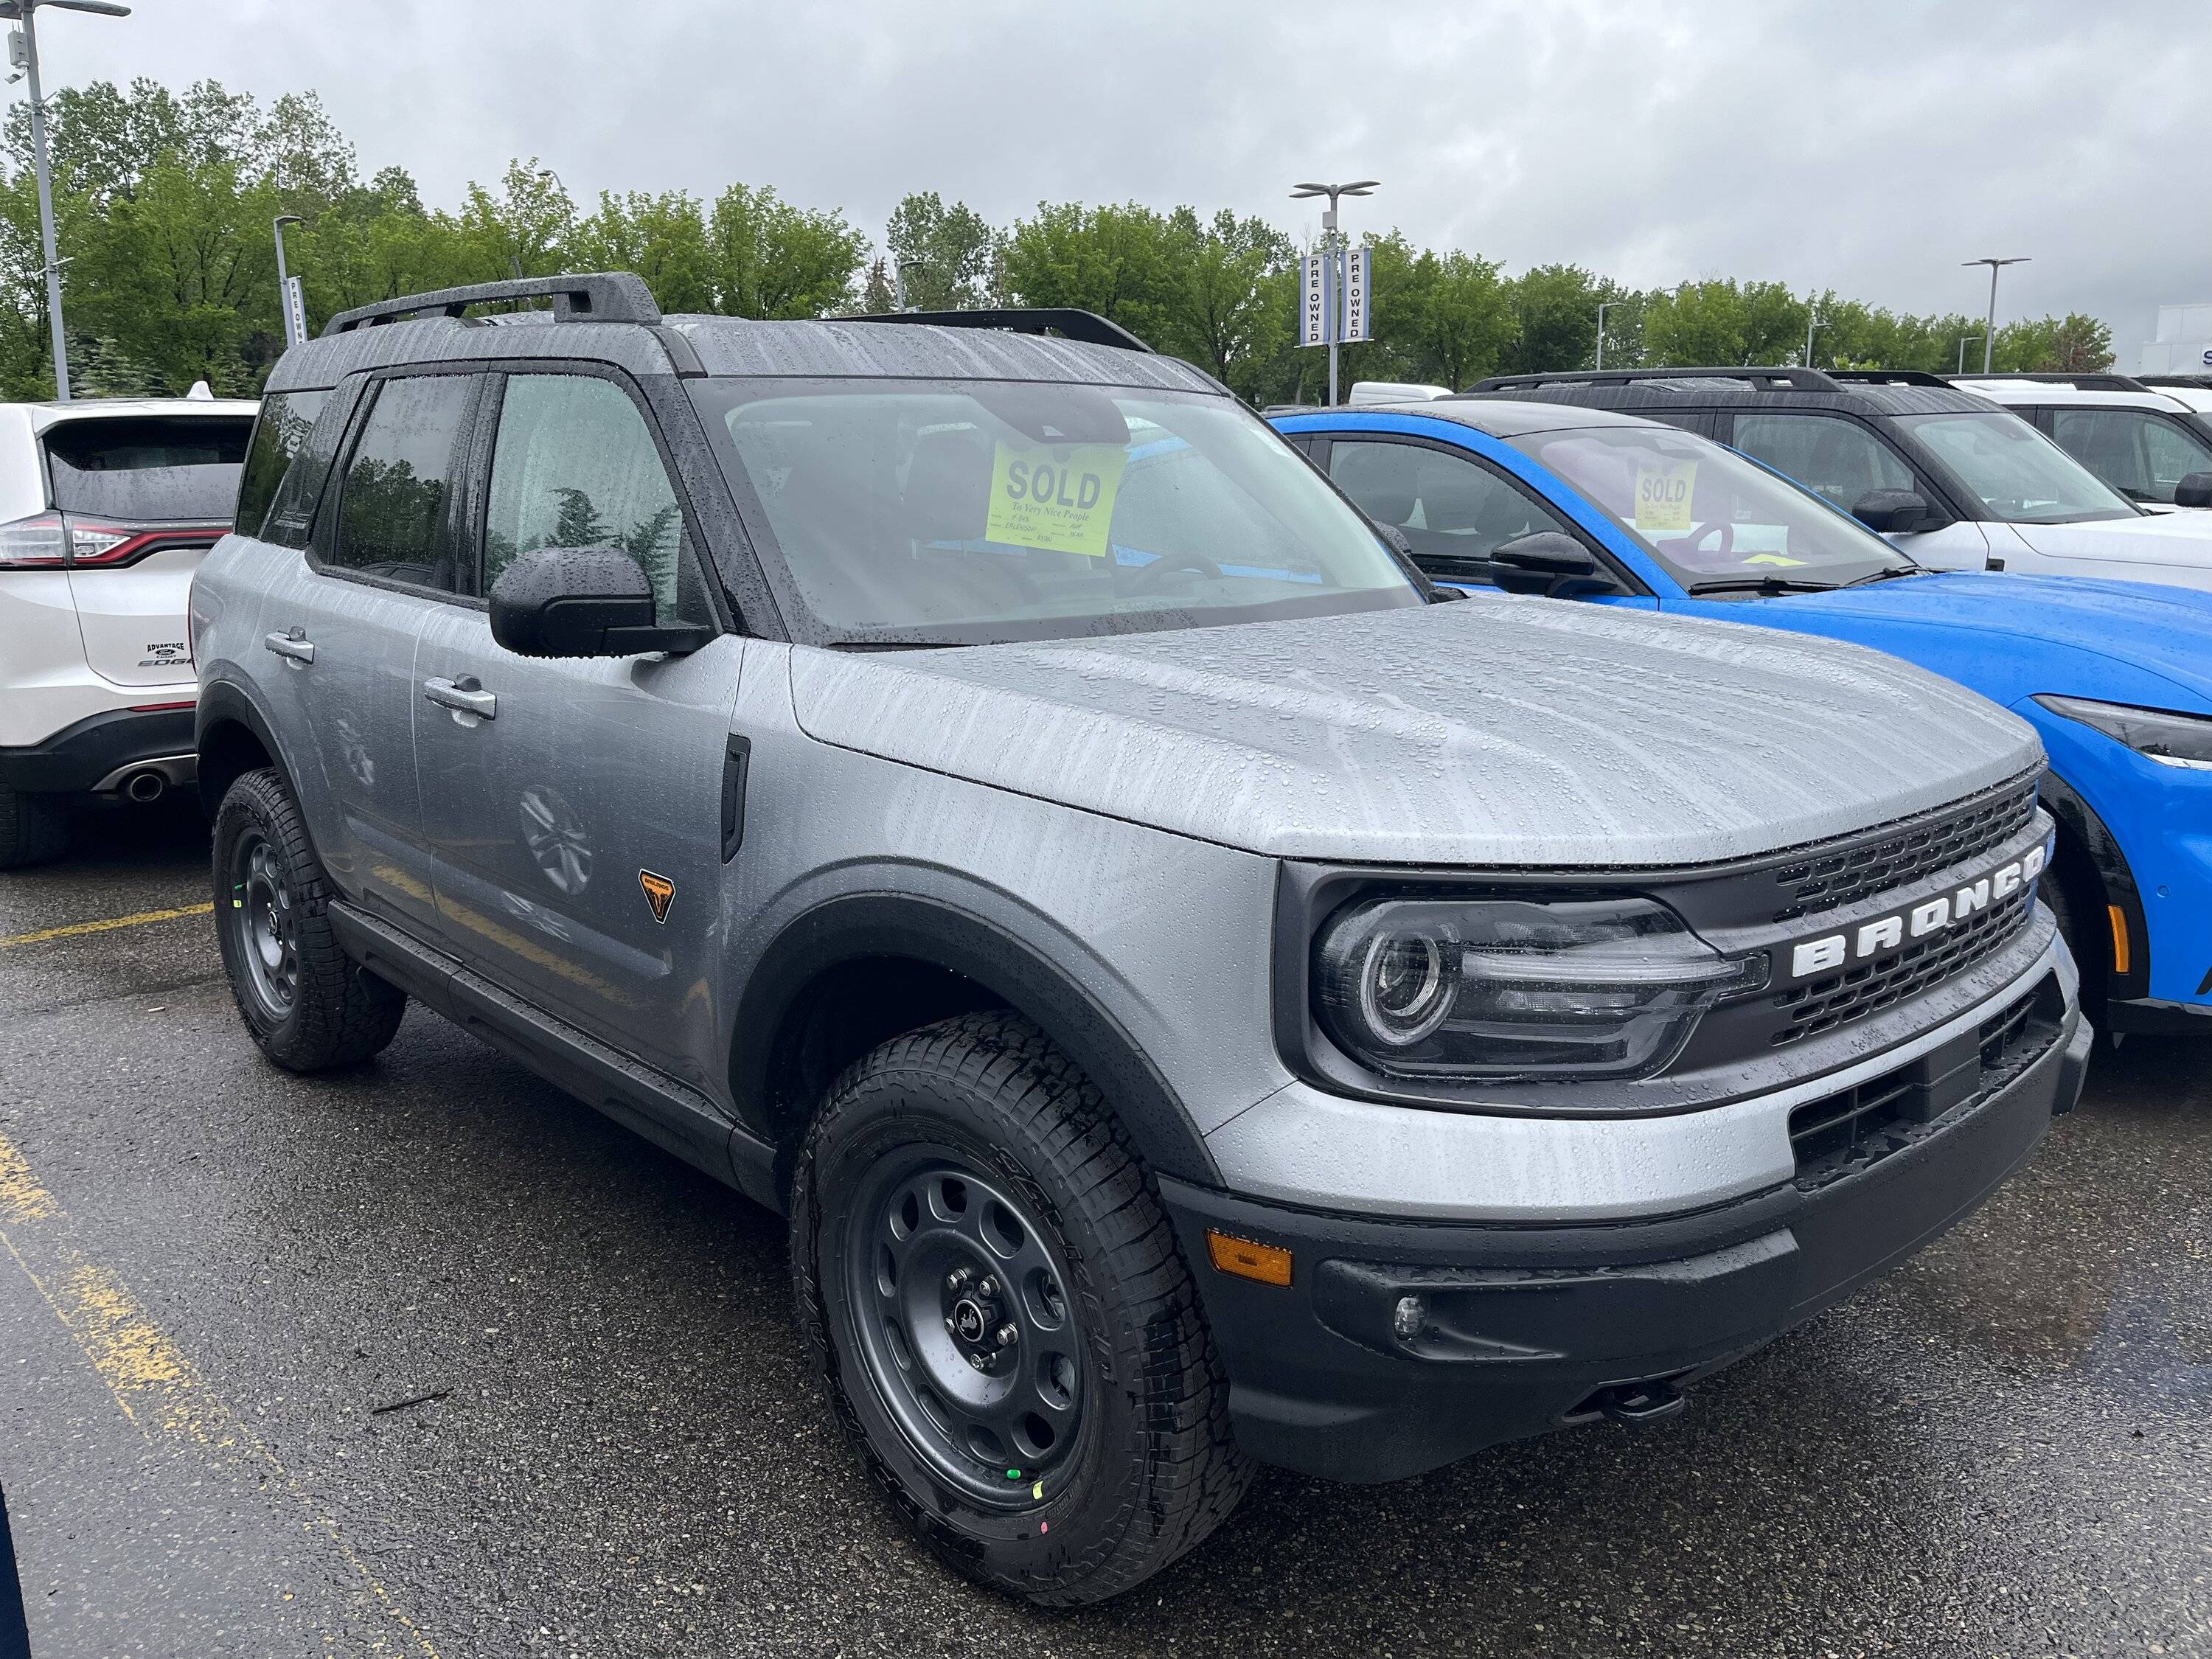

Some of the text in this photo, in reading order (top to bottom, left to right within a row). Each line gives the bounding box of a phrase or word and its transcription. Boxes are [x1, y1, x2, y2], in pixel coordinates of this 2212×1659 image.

[1310, 260, 1321, 341] PRE OWNED
[1350, 254, 1361, 338] PRE OWNED
[1006, 460, 1101, 510] SOLD
[1642, 478, 1686, 502] SOLD
[1012, 501, 1090, 522] To Very Nice People
[147, 642, 184, 653] ADVANTAGE
[1792, 846, 2045, 978] BRONCO
